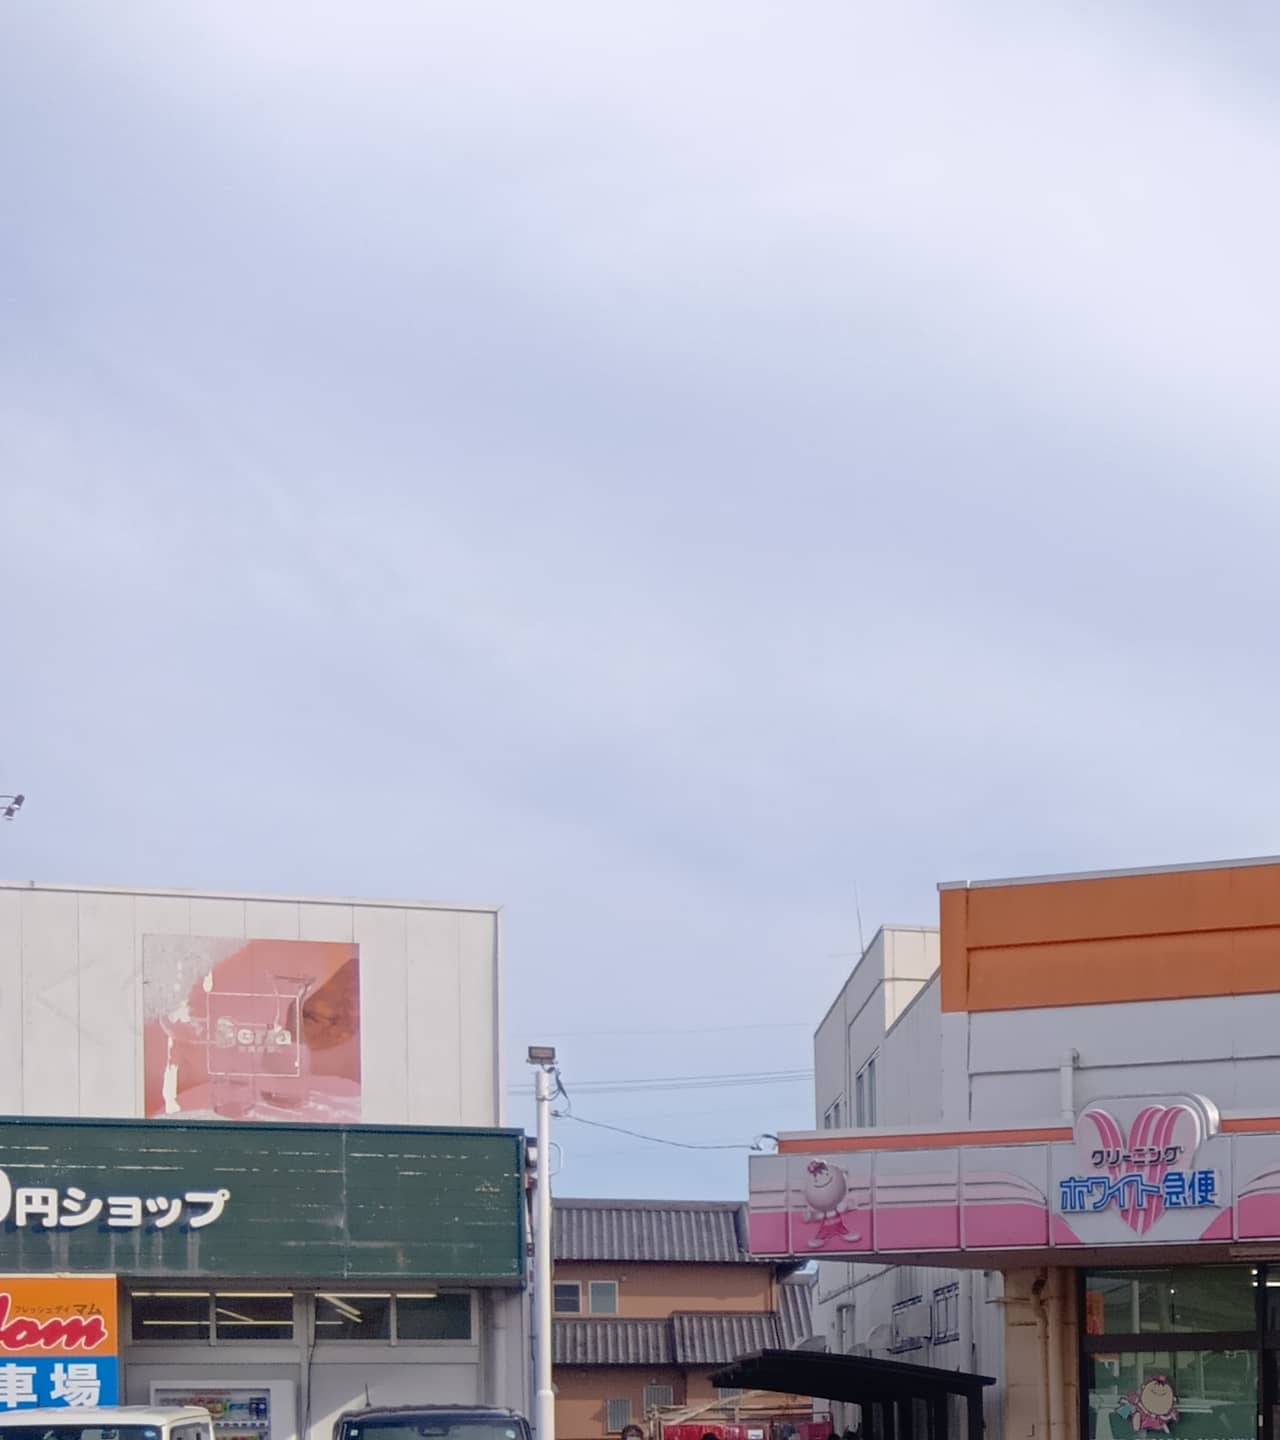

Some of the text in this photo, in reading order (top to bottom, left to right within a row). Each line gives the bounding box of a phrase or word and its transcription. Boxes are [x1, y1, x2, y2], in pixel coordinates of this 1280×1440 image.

[1091, 1145, 1184, 1168] クリーニング
[1060, 1169, 1217, 1213] ホワイト急便
